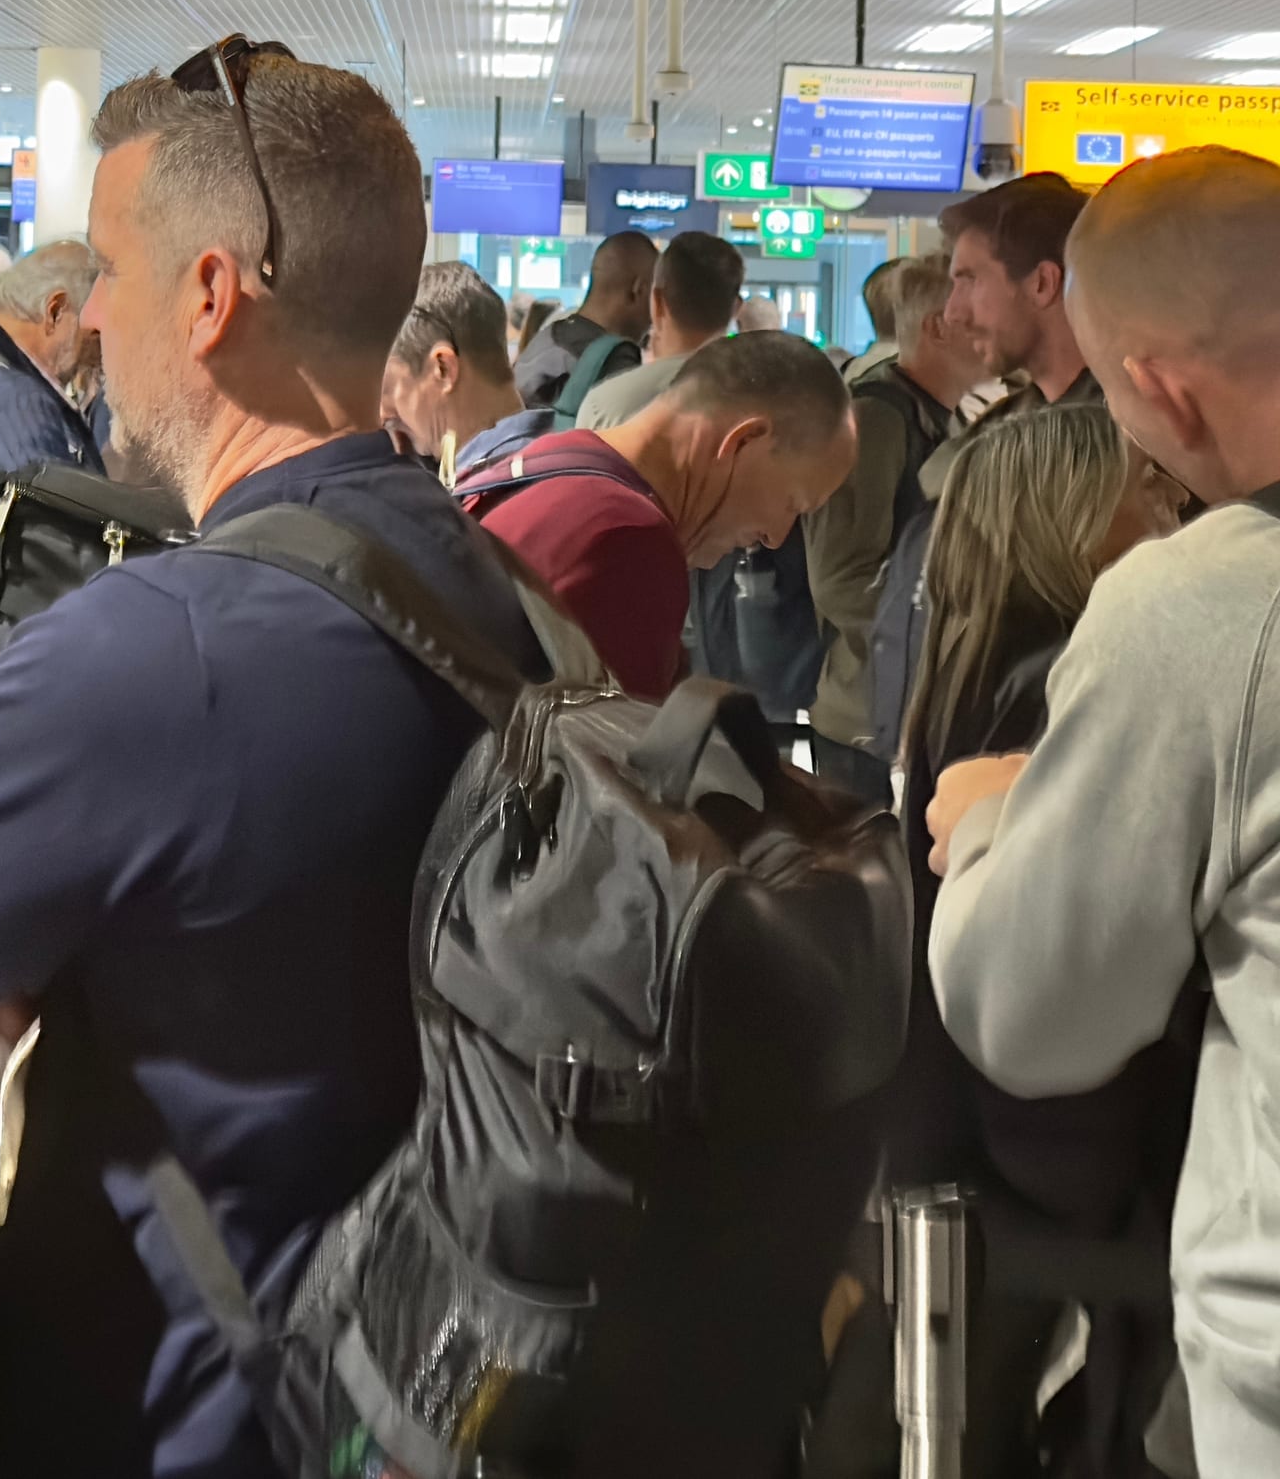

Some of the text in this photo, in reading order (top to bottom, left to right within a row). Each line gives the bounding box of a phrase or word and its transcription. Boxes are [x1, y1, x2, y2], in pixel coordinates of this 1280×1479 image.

[811, 73, 964, 90] lf-service passport control
[1076, 87, 1210, 108] Self-service
[828, 107, 880, 119] Passengers
[920, 111, 938, 120] and
[889, 131, 935, 142] passports
[885, 170, 902, 180] not
[615, 188, 689, 211] BrightSign
